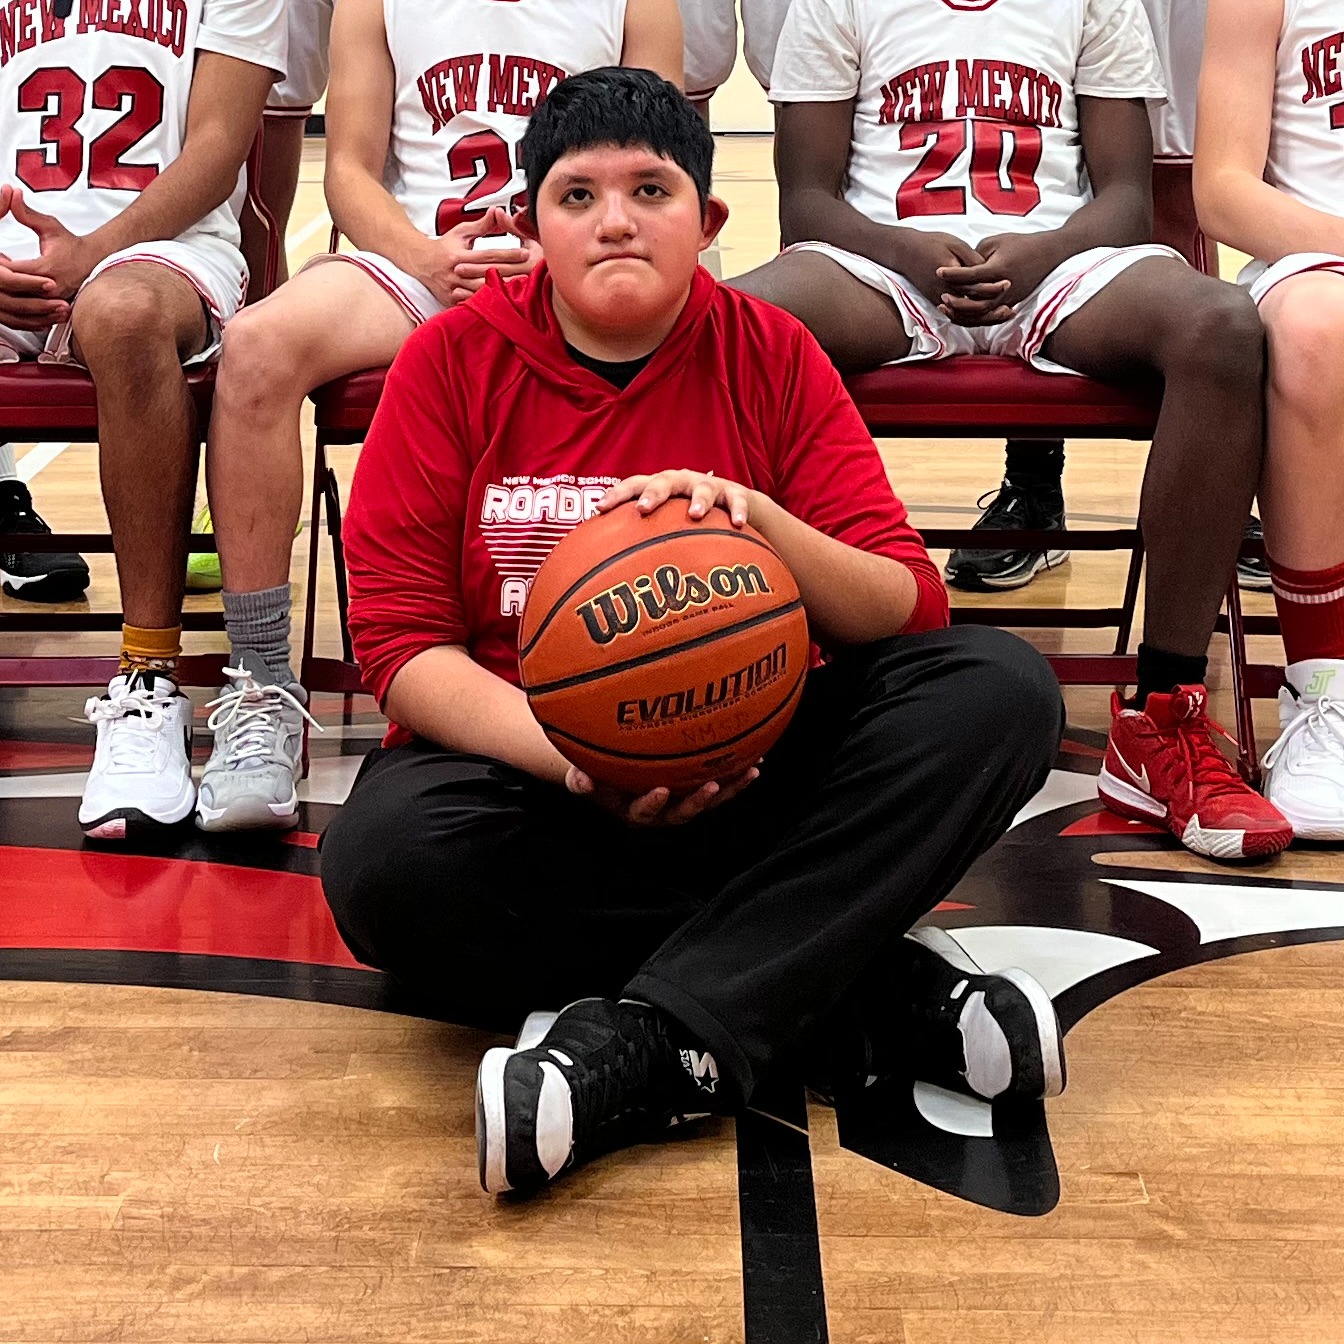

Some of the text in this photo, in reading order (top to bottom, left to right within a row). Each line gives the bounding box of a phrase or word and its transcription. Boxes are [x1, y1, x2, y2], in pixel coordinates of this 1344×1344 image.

[15, 65, 164, 193] 32
[417, 53, 567, 135] NEW MEX
[879, 59, 1063, 128] NEW MEXICO
[435, 129, 537, 240] 2
[896, 119, 1042, 220] 20
[481, 484, 606, 523] ROADR
[503, 474, 621, 486] NEW MEXICO SCHOO
[574, 563, 770, 645] Wilson
[617, 642, 787, 726] EVOLUTION
